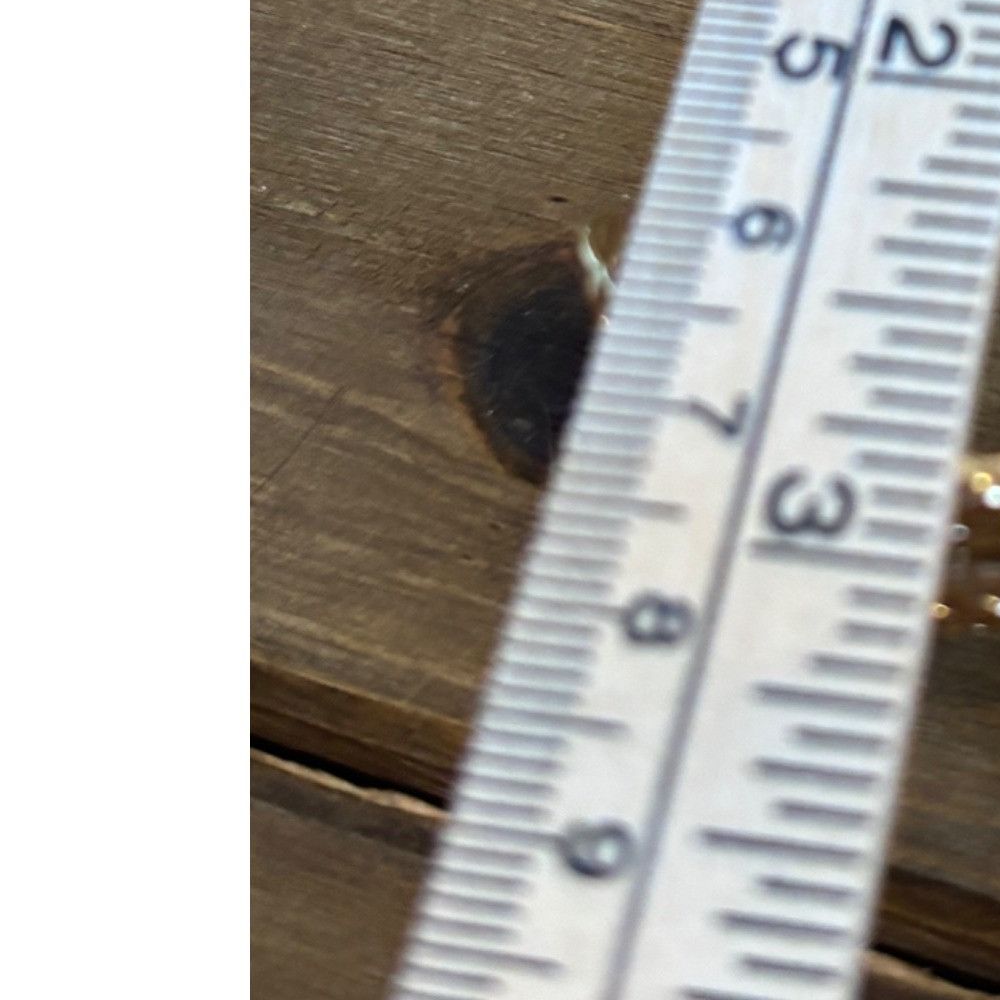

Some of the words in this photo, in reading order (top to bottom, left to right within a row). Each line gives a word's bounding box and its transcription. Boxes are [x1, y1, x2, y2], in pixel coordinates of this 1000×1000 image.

[774, 34, 853, 81] 5
[880, 16, 959, 69] 2
[733, 204, 795, 250] 6
[690, 391, 749, 441] 7
[765, 468, 856, 538] 3
[618, 590, 693, 647] 8
[560, 817, 636, 878] 9
